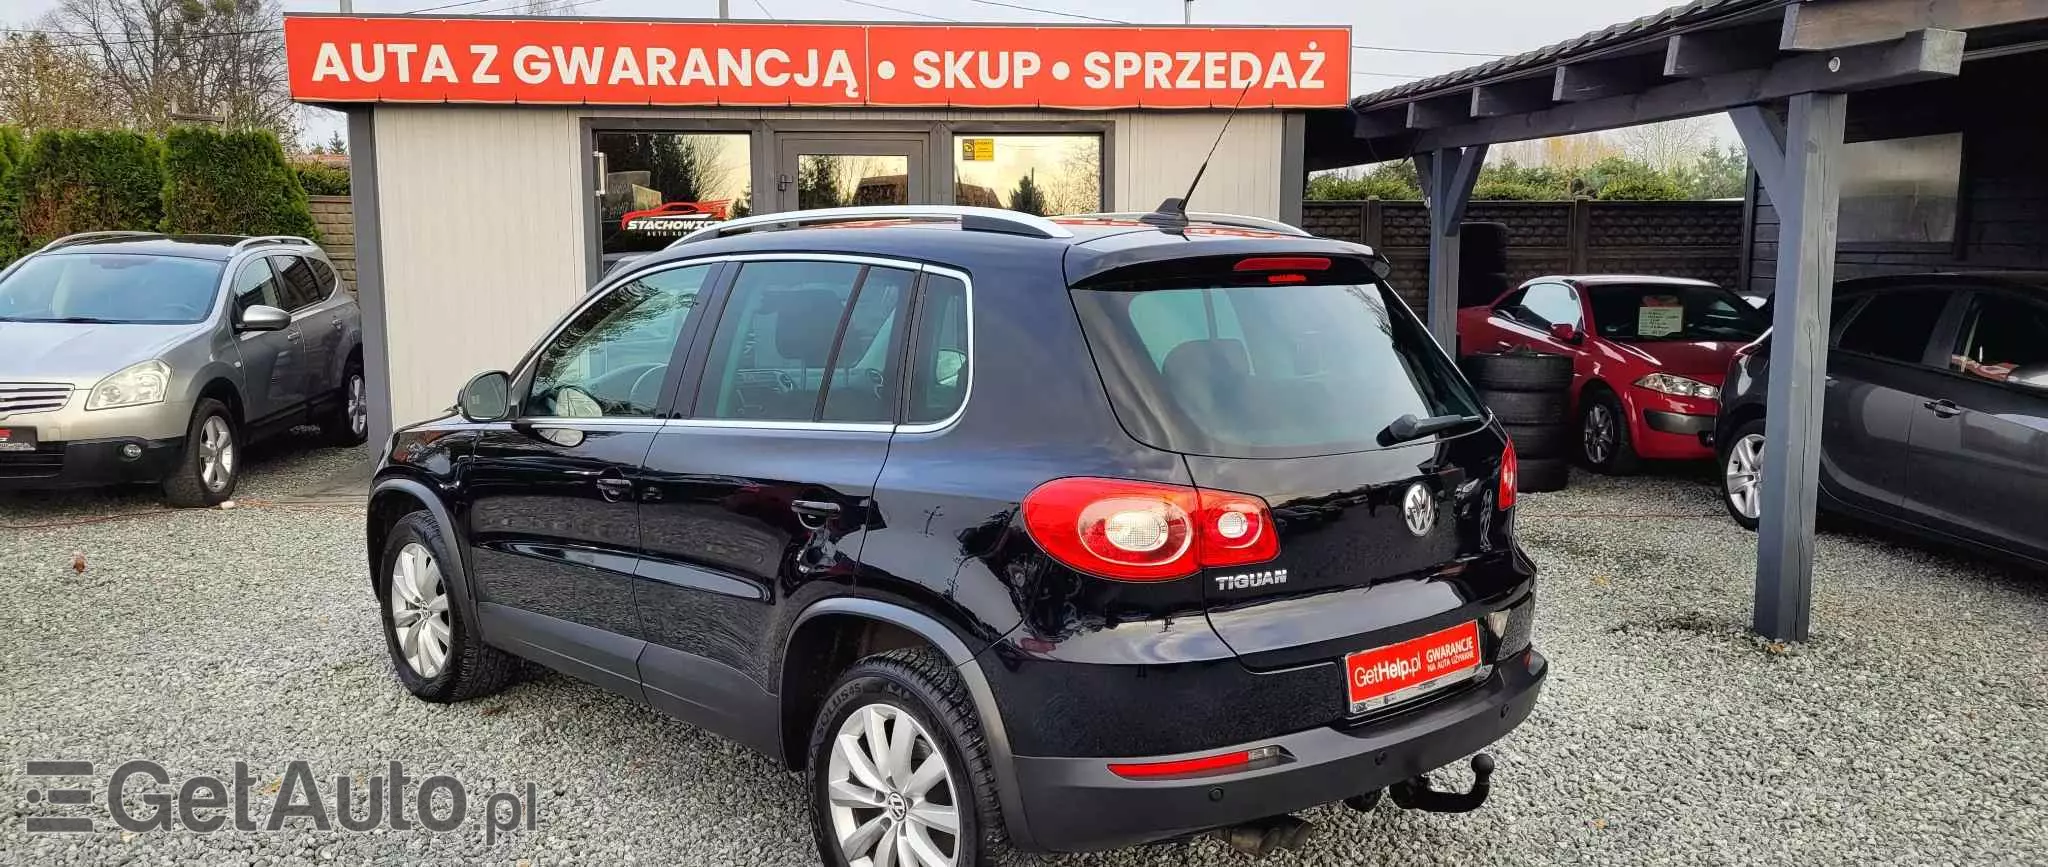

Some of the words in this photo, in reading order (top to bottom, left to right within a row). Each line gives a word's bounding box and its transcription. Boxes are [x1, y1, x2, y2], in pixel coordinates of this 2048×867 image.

[311, 42, 459, 84] AUTA
[469, 44, 501, 84] Z
[512, 45, 860, 98] GWARANCJĄ
[912, 50, 1042, 90] SKUP
[1083, 40, 1327, 90] SPRZEDAŻ
[1215, 569, 1288, 591] TIGUAN
[1426, 637, 1474, 662] GWARANCJE
[1354, 651, 1422, 688] GetHelp.pl
